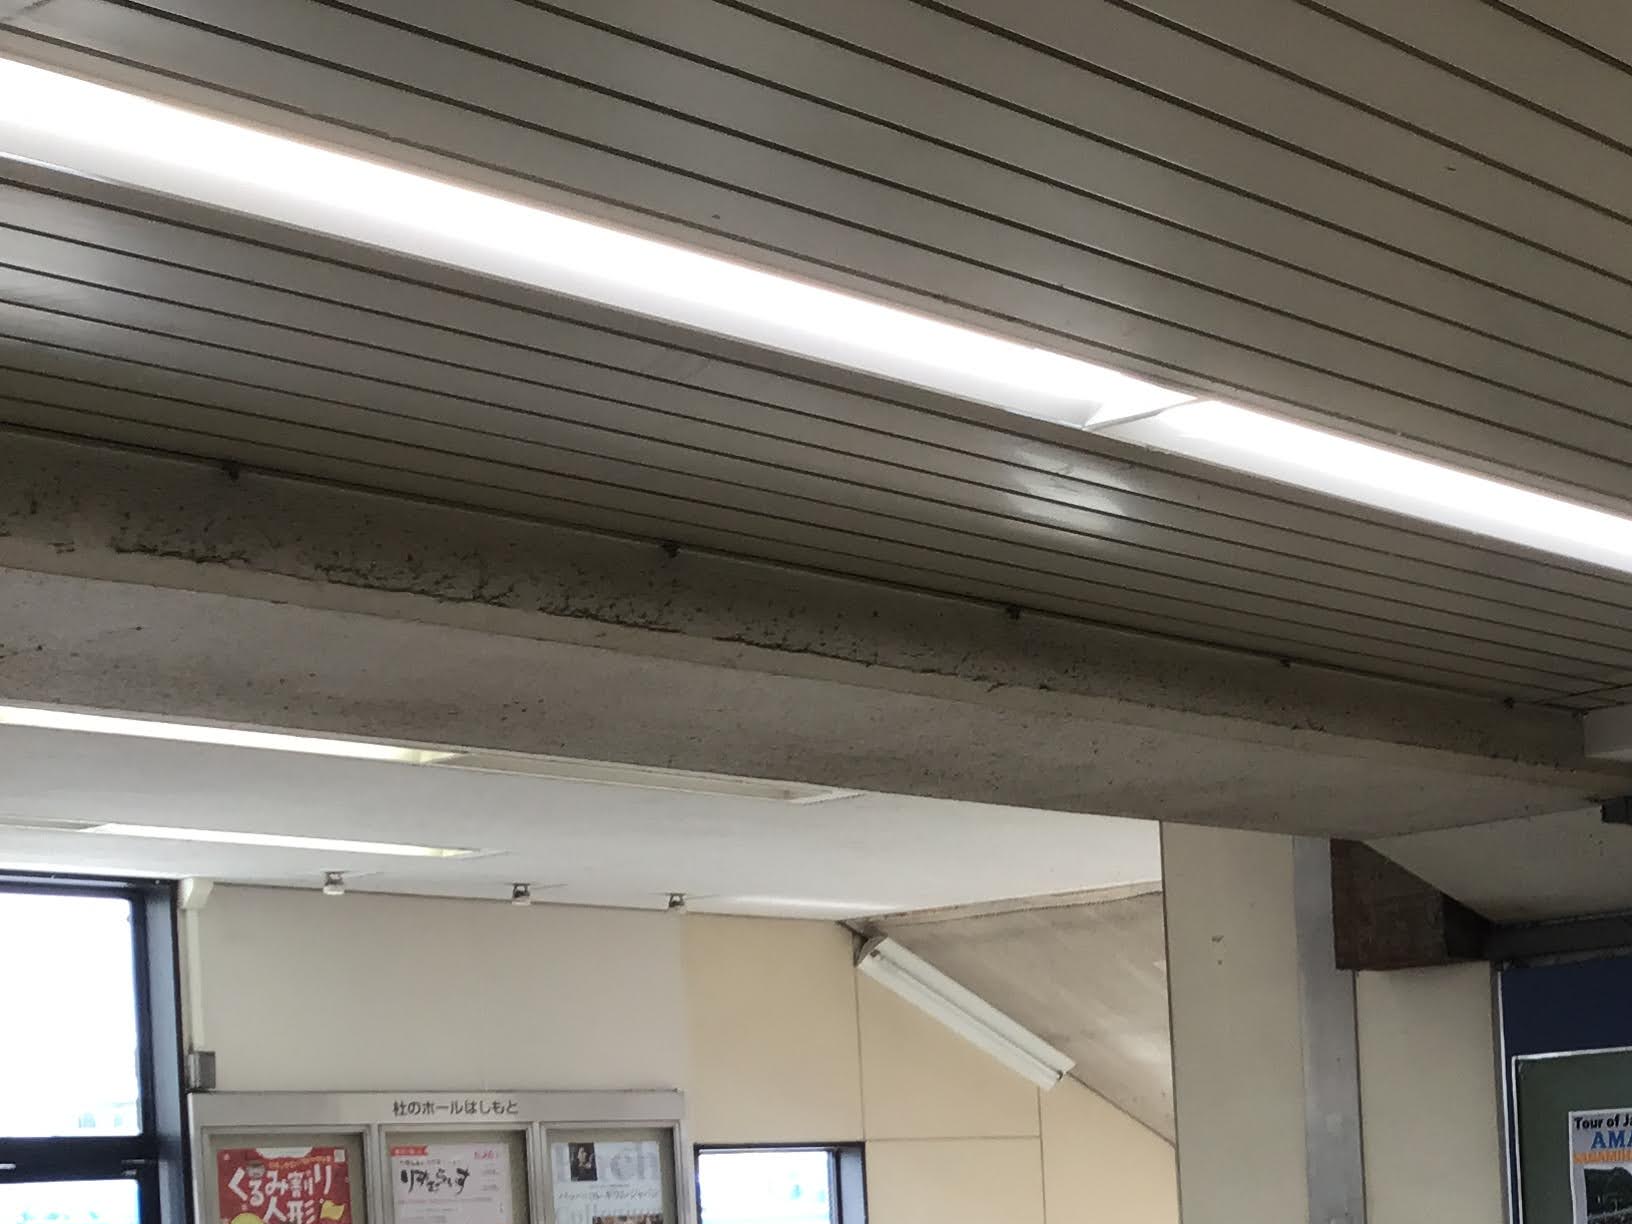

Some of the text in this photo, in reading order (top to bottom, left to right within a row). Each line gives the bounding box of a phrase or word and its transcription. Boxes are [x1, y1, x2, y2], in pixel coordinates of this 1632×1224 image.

[1574, 1116, 1603, 1130] Tour
[1606, 1113, 1620, 1128] of
[228, 1163, 332, 1207] くるみ割り
